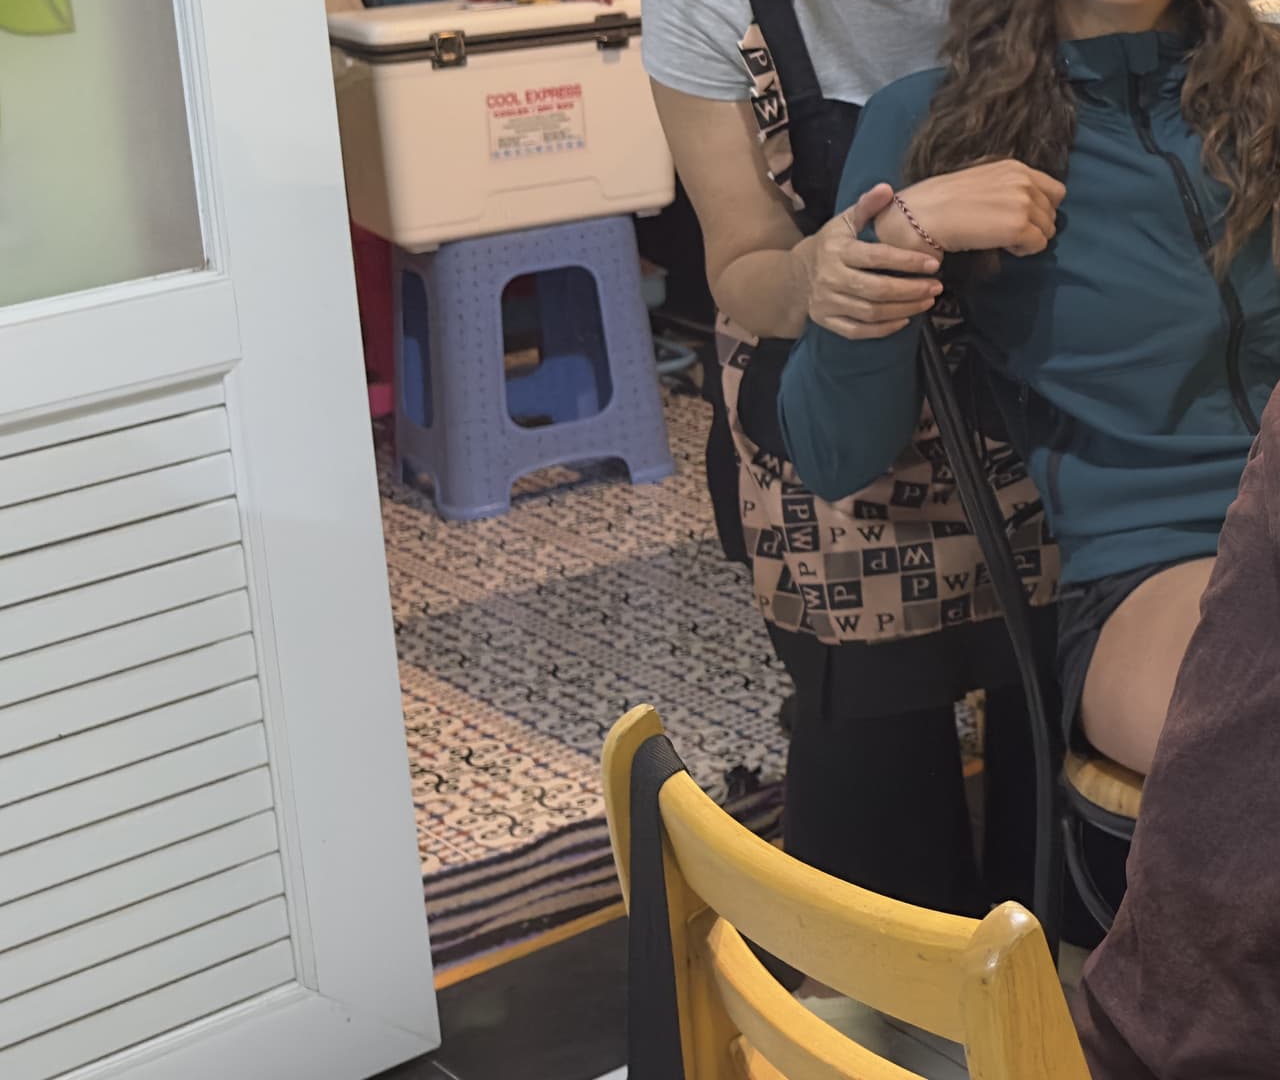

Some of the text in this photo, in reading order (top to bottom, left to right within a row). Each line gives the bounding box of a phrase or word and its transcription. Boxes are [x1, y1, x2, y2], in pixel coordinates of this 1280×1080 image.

[487, 91, 521, 109] COOL
[830, 524, 885, 545] P W
[911, 573, 970, 597] P W
[835, 613, 896, 634] W P
